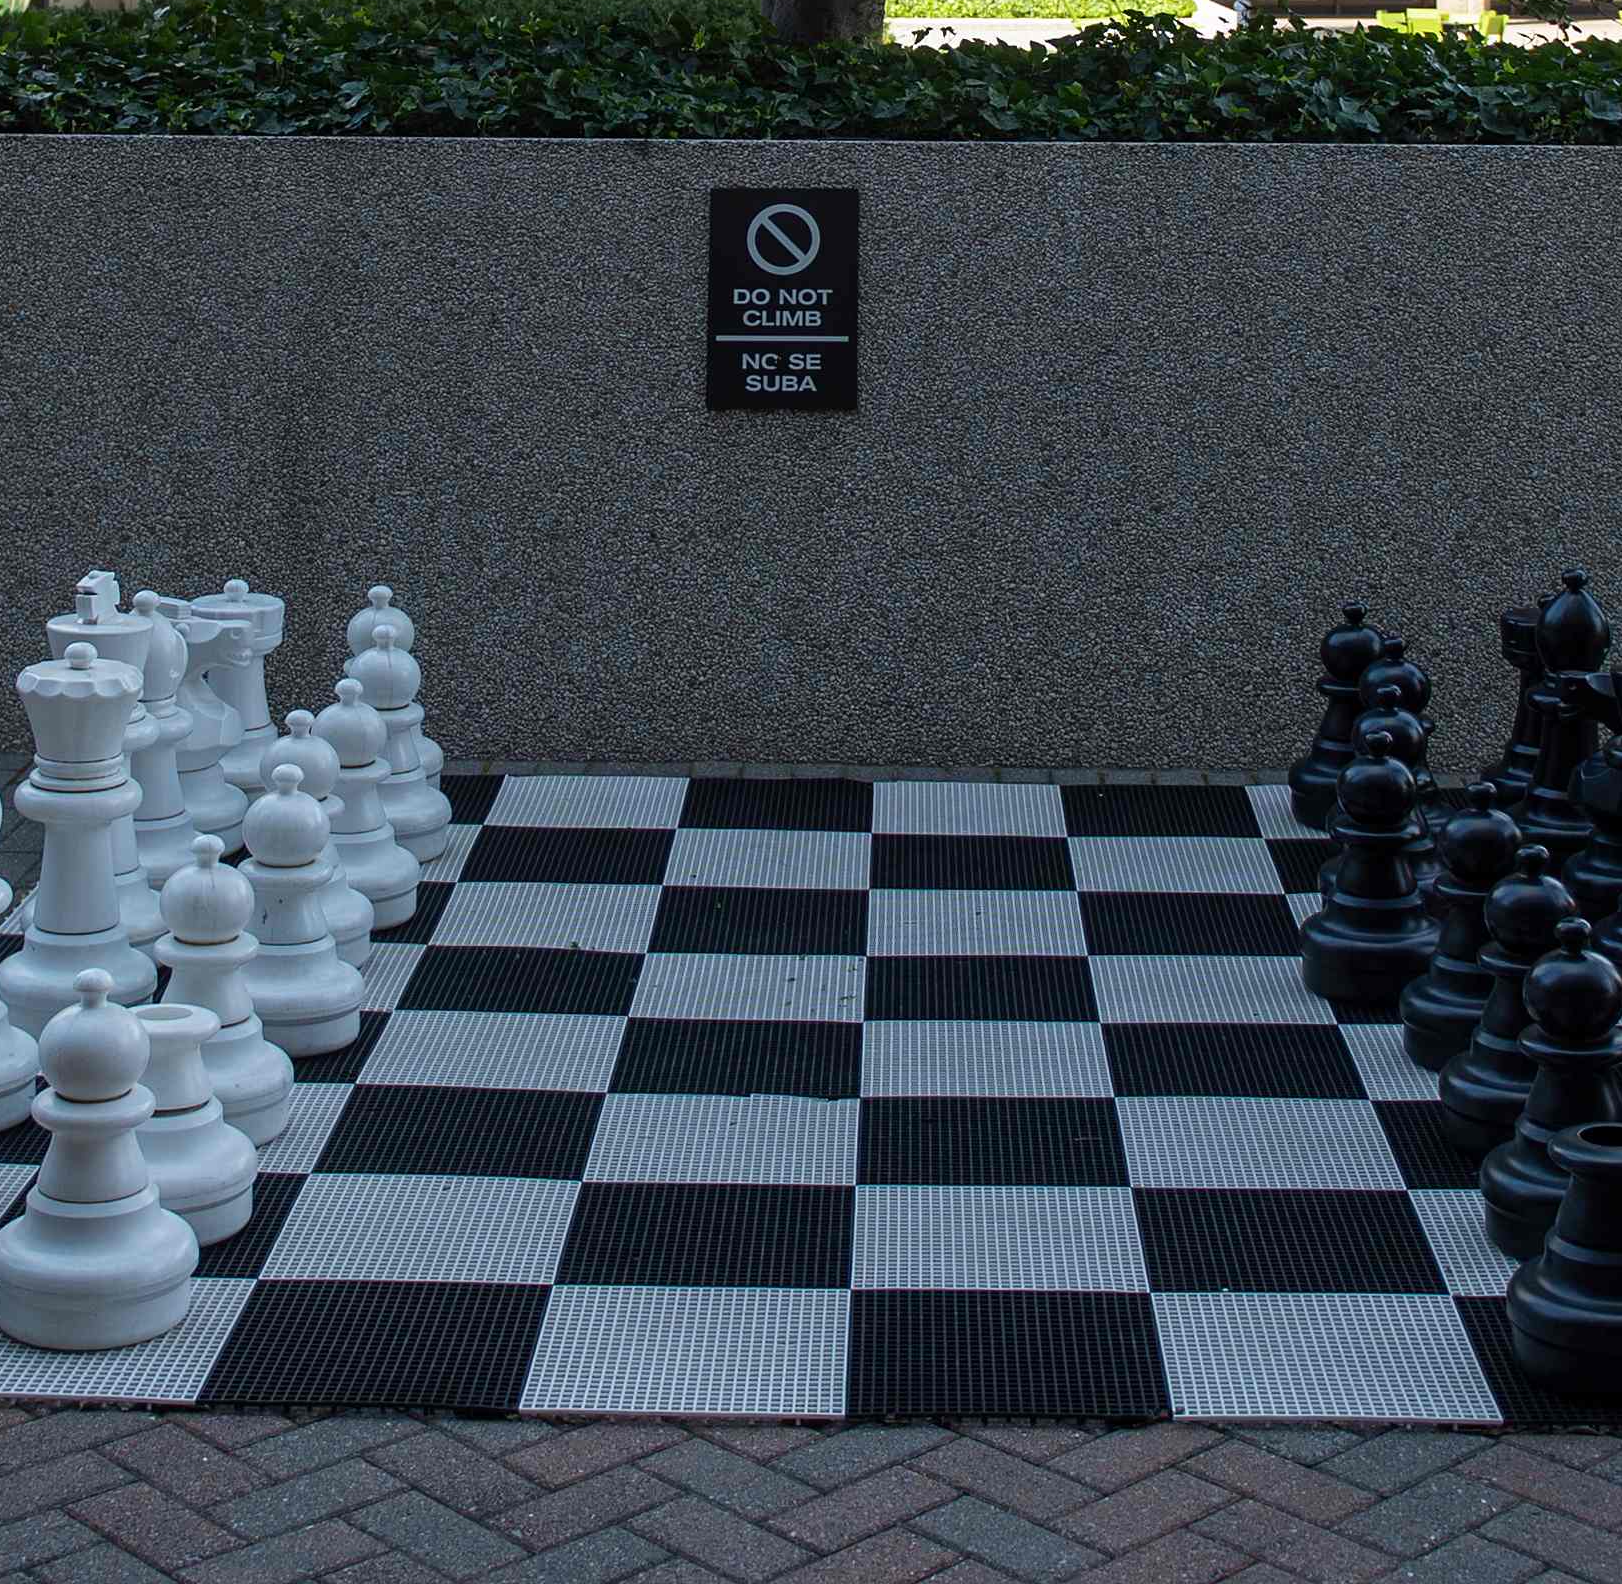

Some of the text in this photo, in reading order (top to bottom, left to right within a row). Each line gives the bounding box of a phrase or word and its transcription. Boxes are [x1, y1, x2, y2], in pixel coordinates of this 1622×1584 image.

[733, 288, 834, 306] DO NOT
[743, 310, 822, 327] CLIMB
[788, 353, 823, 371] SE
[745, 375, 818, 392] SUBA
